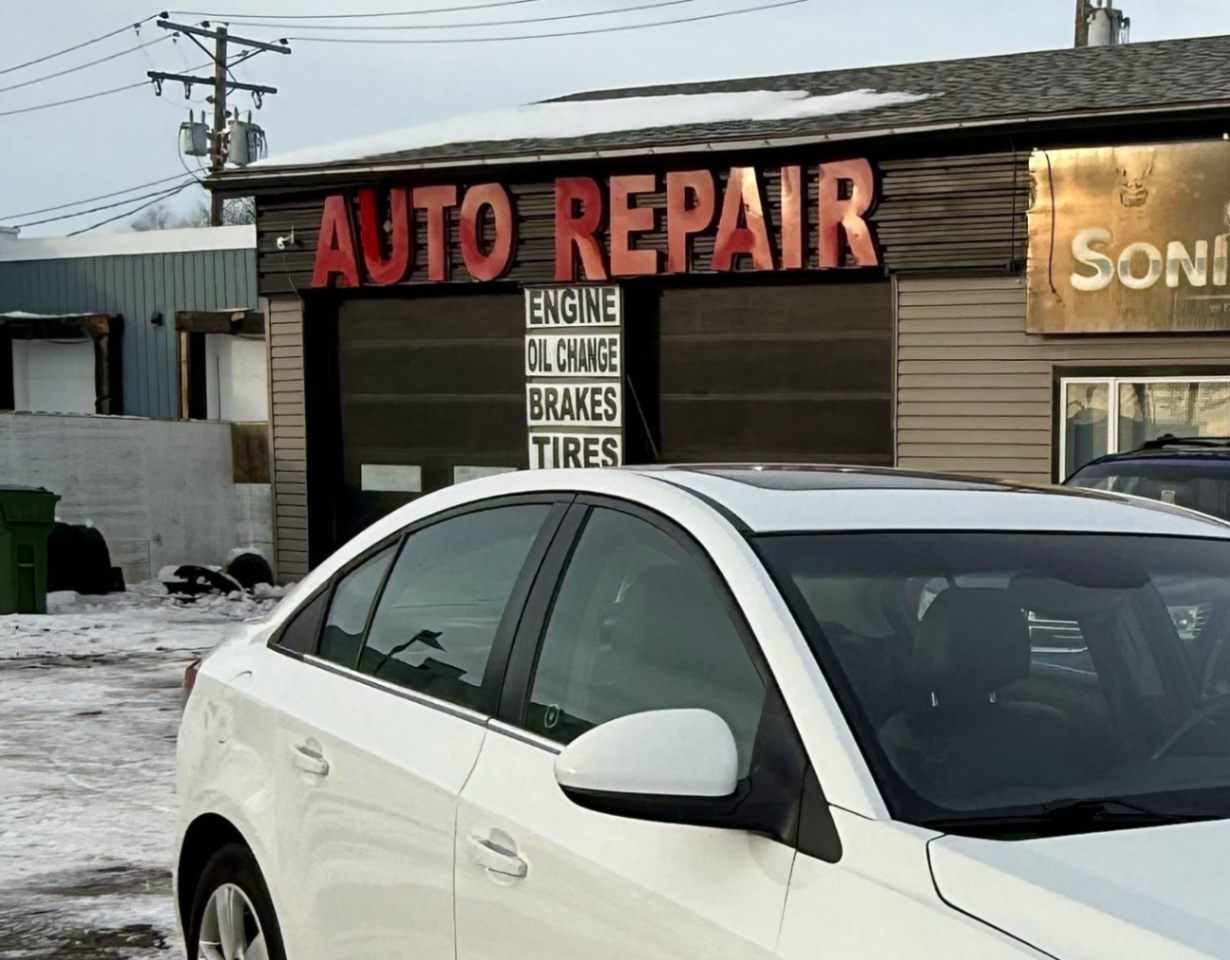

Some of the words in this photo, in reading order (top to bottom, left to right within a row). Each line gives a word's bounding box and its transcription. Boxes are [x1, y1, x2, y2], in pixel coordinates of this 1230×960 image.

[311, 182, 512, 287] AUTO
[555, 158, 878, 281] REPAIR
[1070, 227, 1228, 291] SONI
[529, 288, 616, 324] ENGINE
[528, 339, 552, 372] OIL
[557, 337, 618, 372] CHANGE
[529, 387, 617, 421] BRAKES
[532, 436, 618, 468] TIRES
